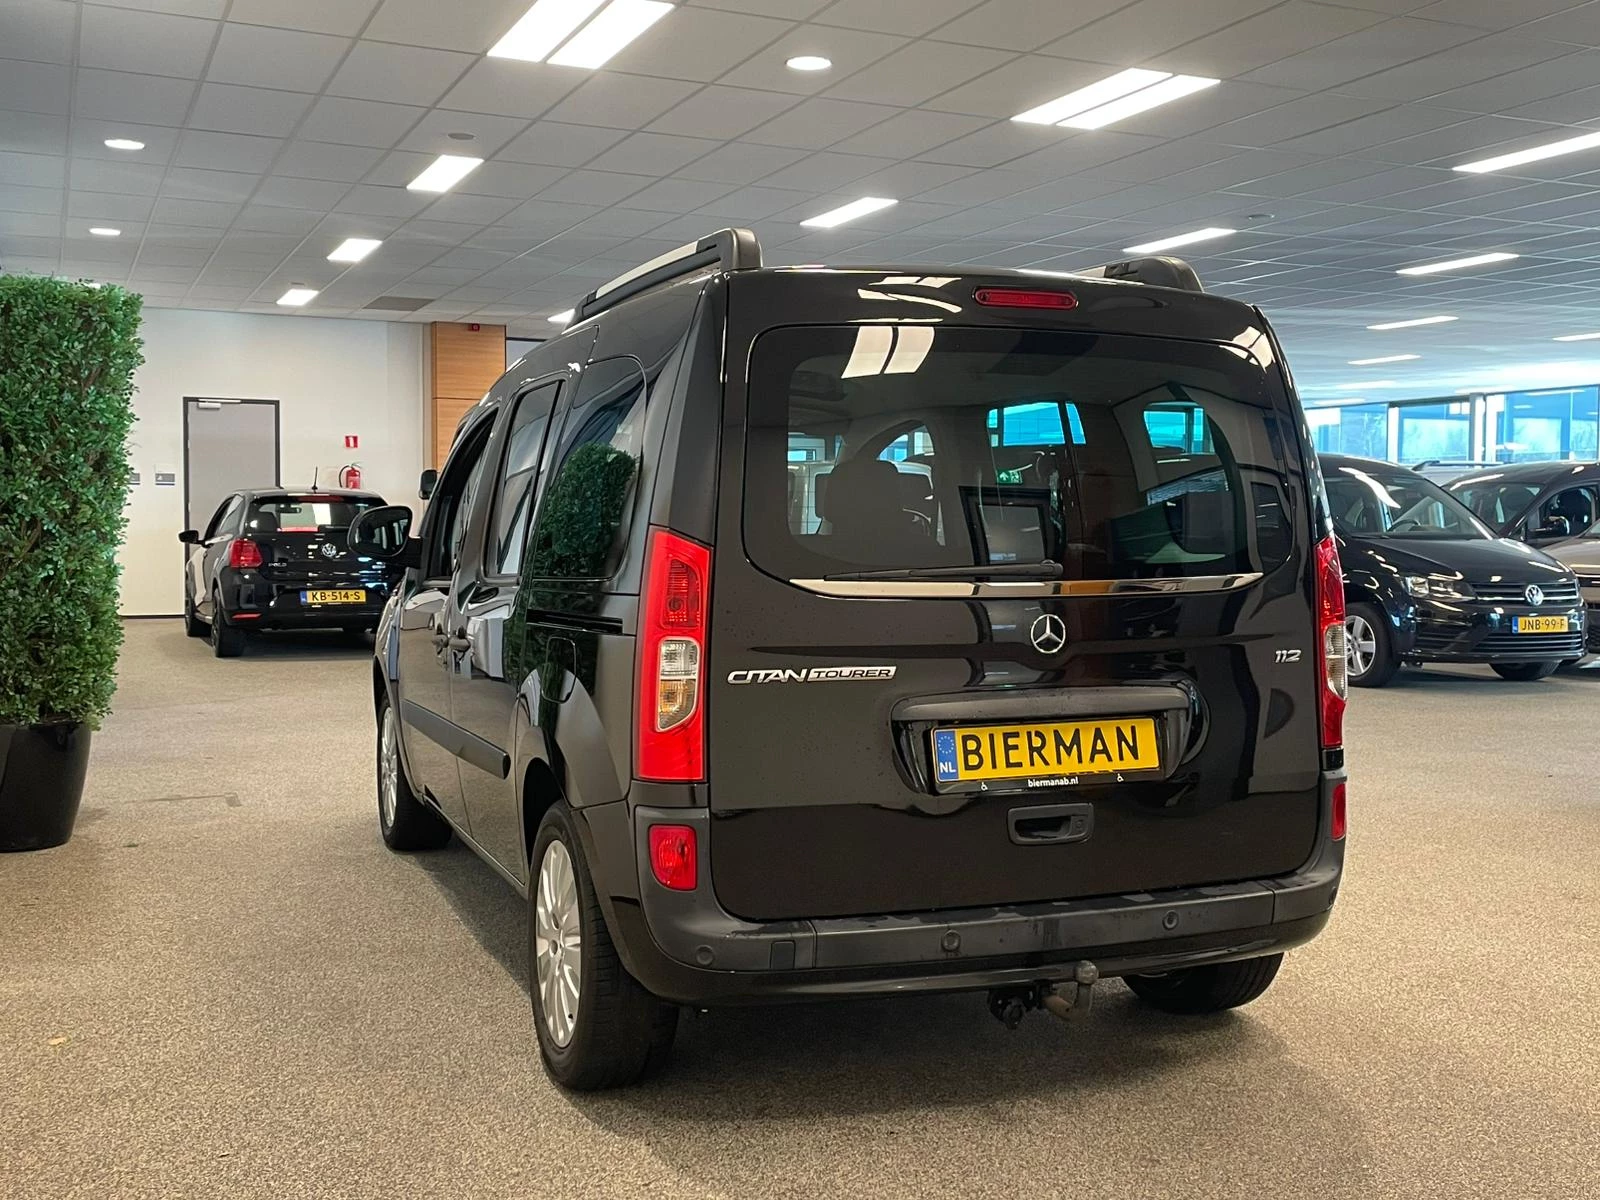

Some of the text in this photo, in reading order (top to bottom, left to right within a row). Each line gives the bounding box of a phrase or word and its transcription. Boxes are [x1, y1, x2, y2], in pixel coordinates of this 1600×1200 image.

[311, 591, 361, 602] KB-514-S
[1521, 618, 1565, 631] JNB-99-F
[1275, 649, 1302, 663] 112
[727, 668, 893, 684] CITAN TOURER
[960, 725, 1140, 772] BIERMAN
[939, 761, 957, 774] NL
[1027, 776, 1079, 788] biermanab.nl
